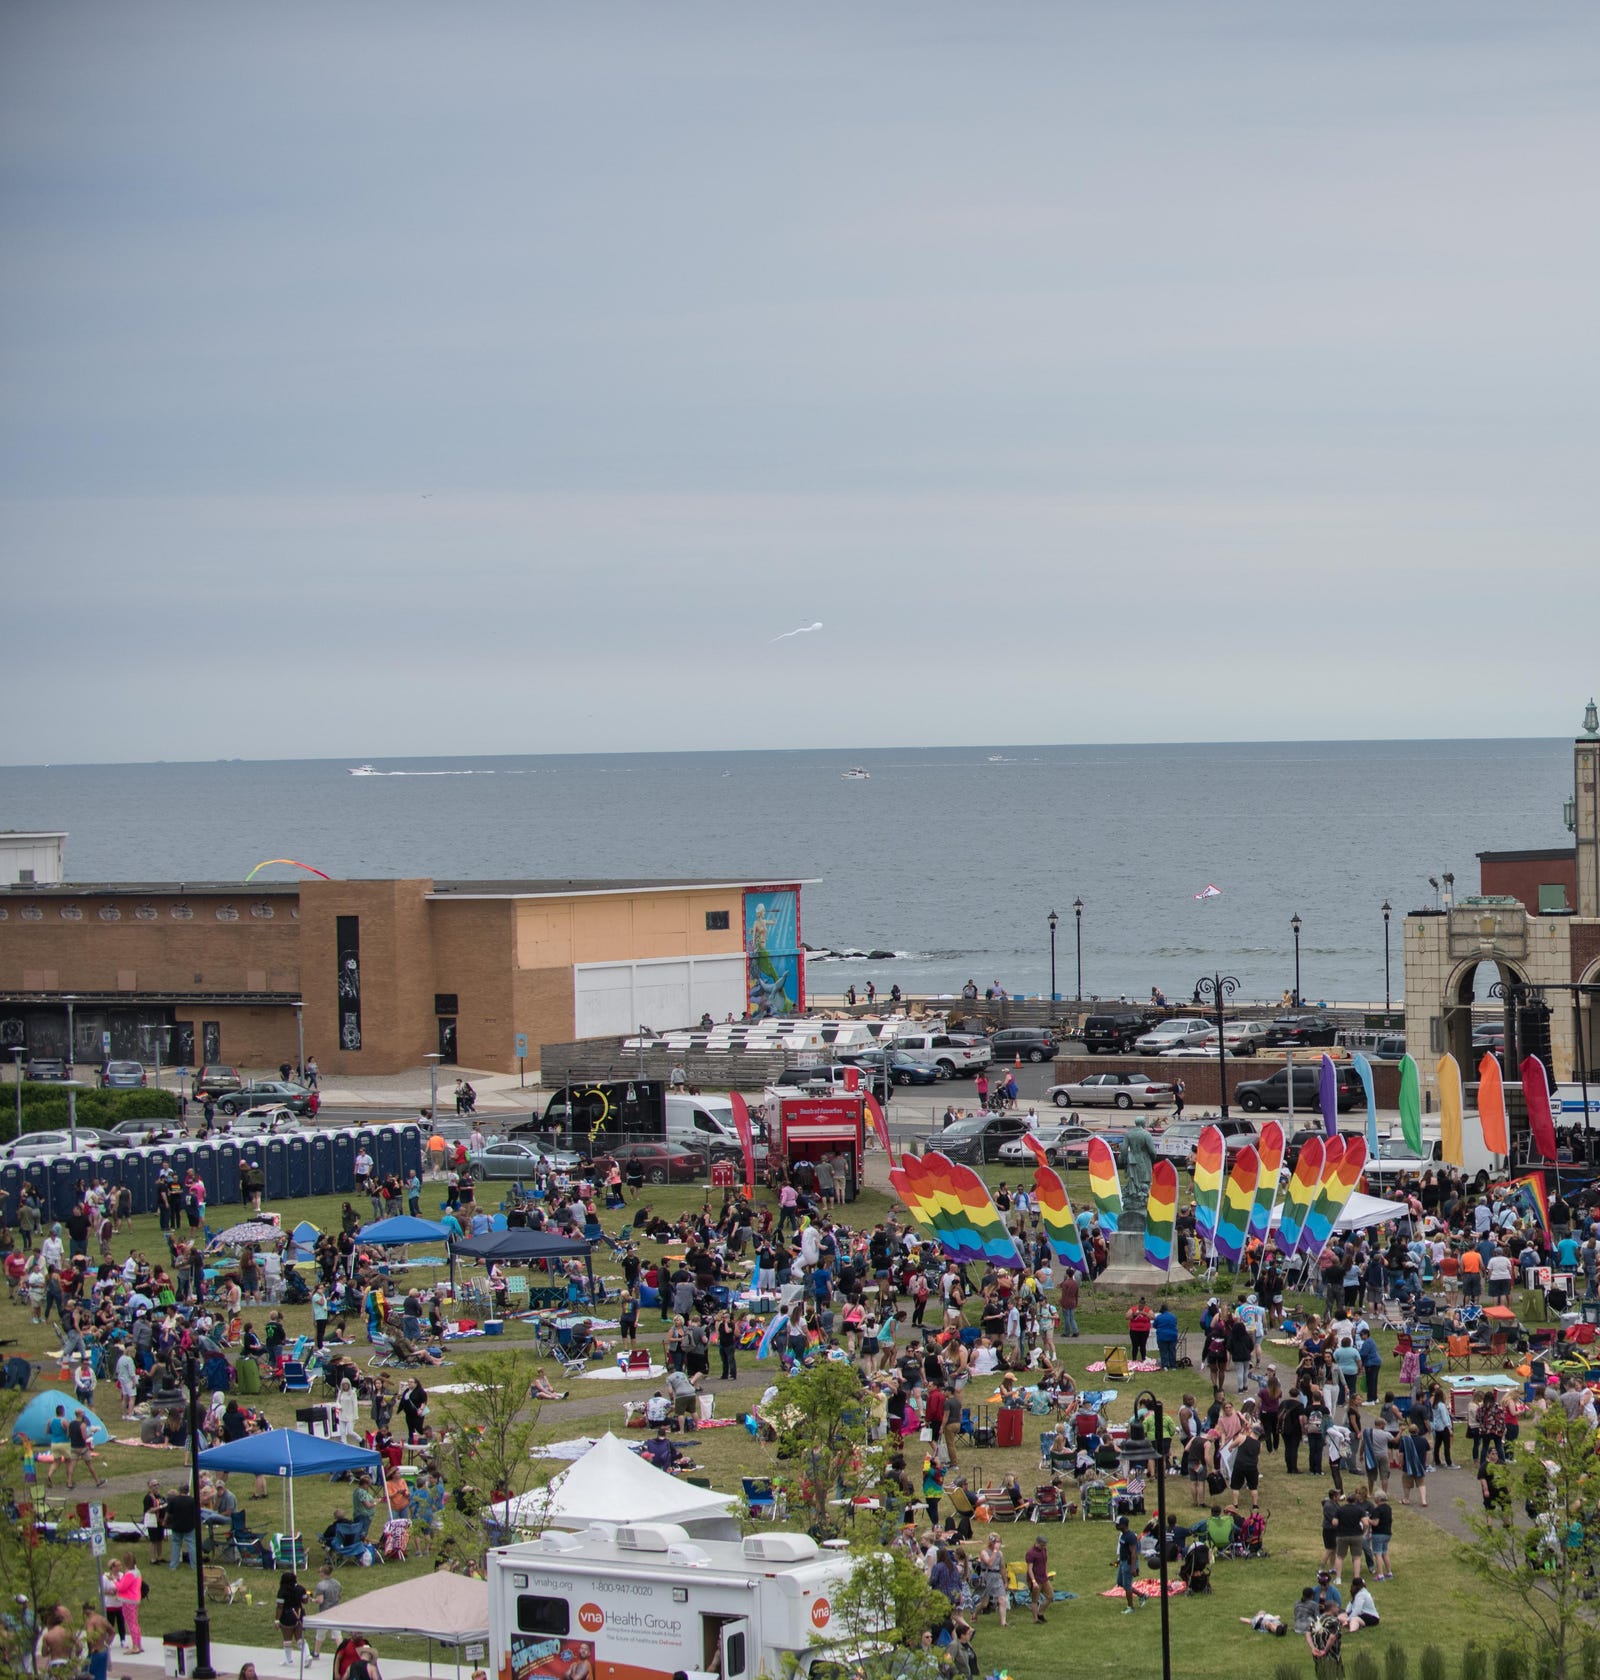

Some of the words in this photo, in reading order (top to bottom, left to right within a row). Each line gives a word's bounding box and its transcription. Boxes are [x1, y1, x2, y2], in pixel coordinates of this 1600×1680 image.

[534, 1576, 573, 1590] vnahg.org
[591, 1582, 653, 1596] 1-800-947-0020
[812, 1607, 830, 1619] vna
[580, 1611, 603, 1624] vna
[605, 1611, 642, 1627] Health
[644, 1614, 682, 1632] Group
[512, 1638, 561, 1672] SUPERHERO
